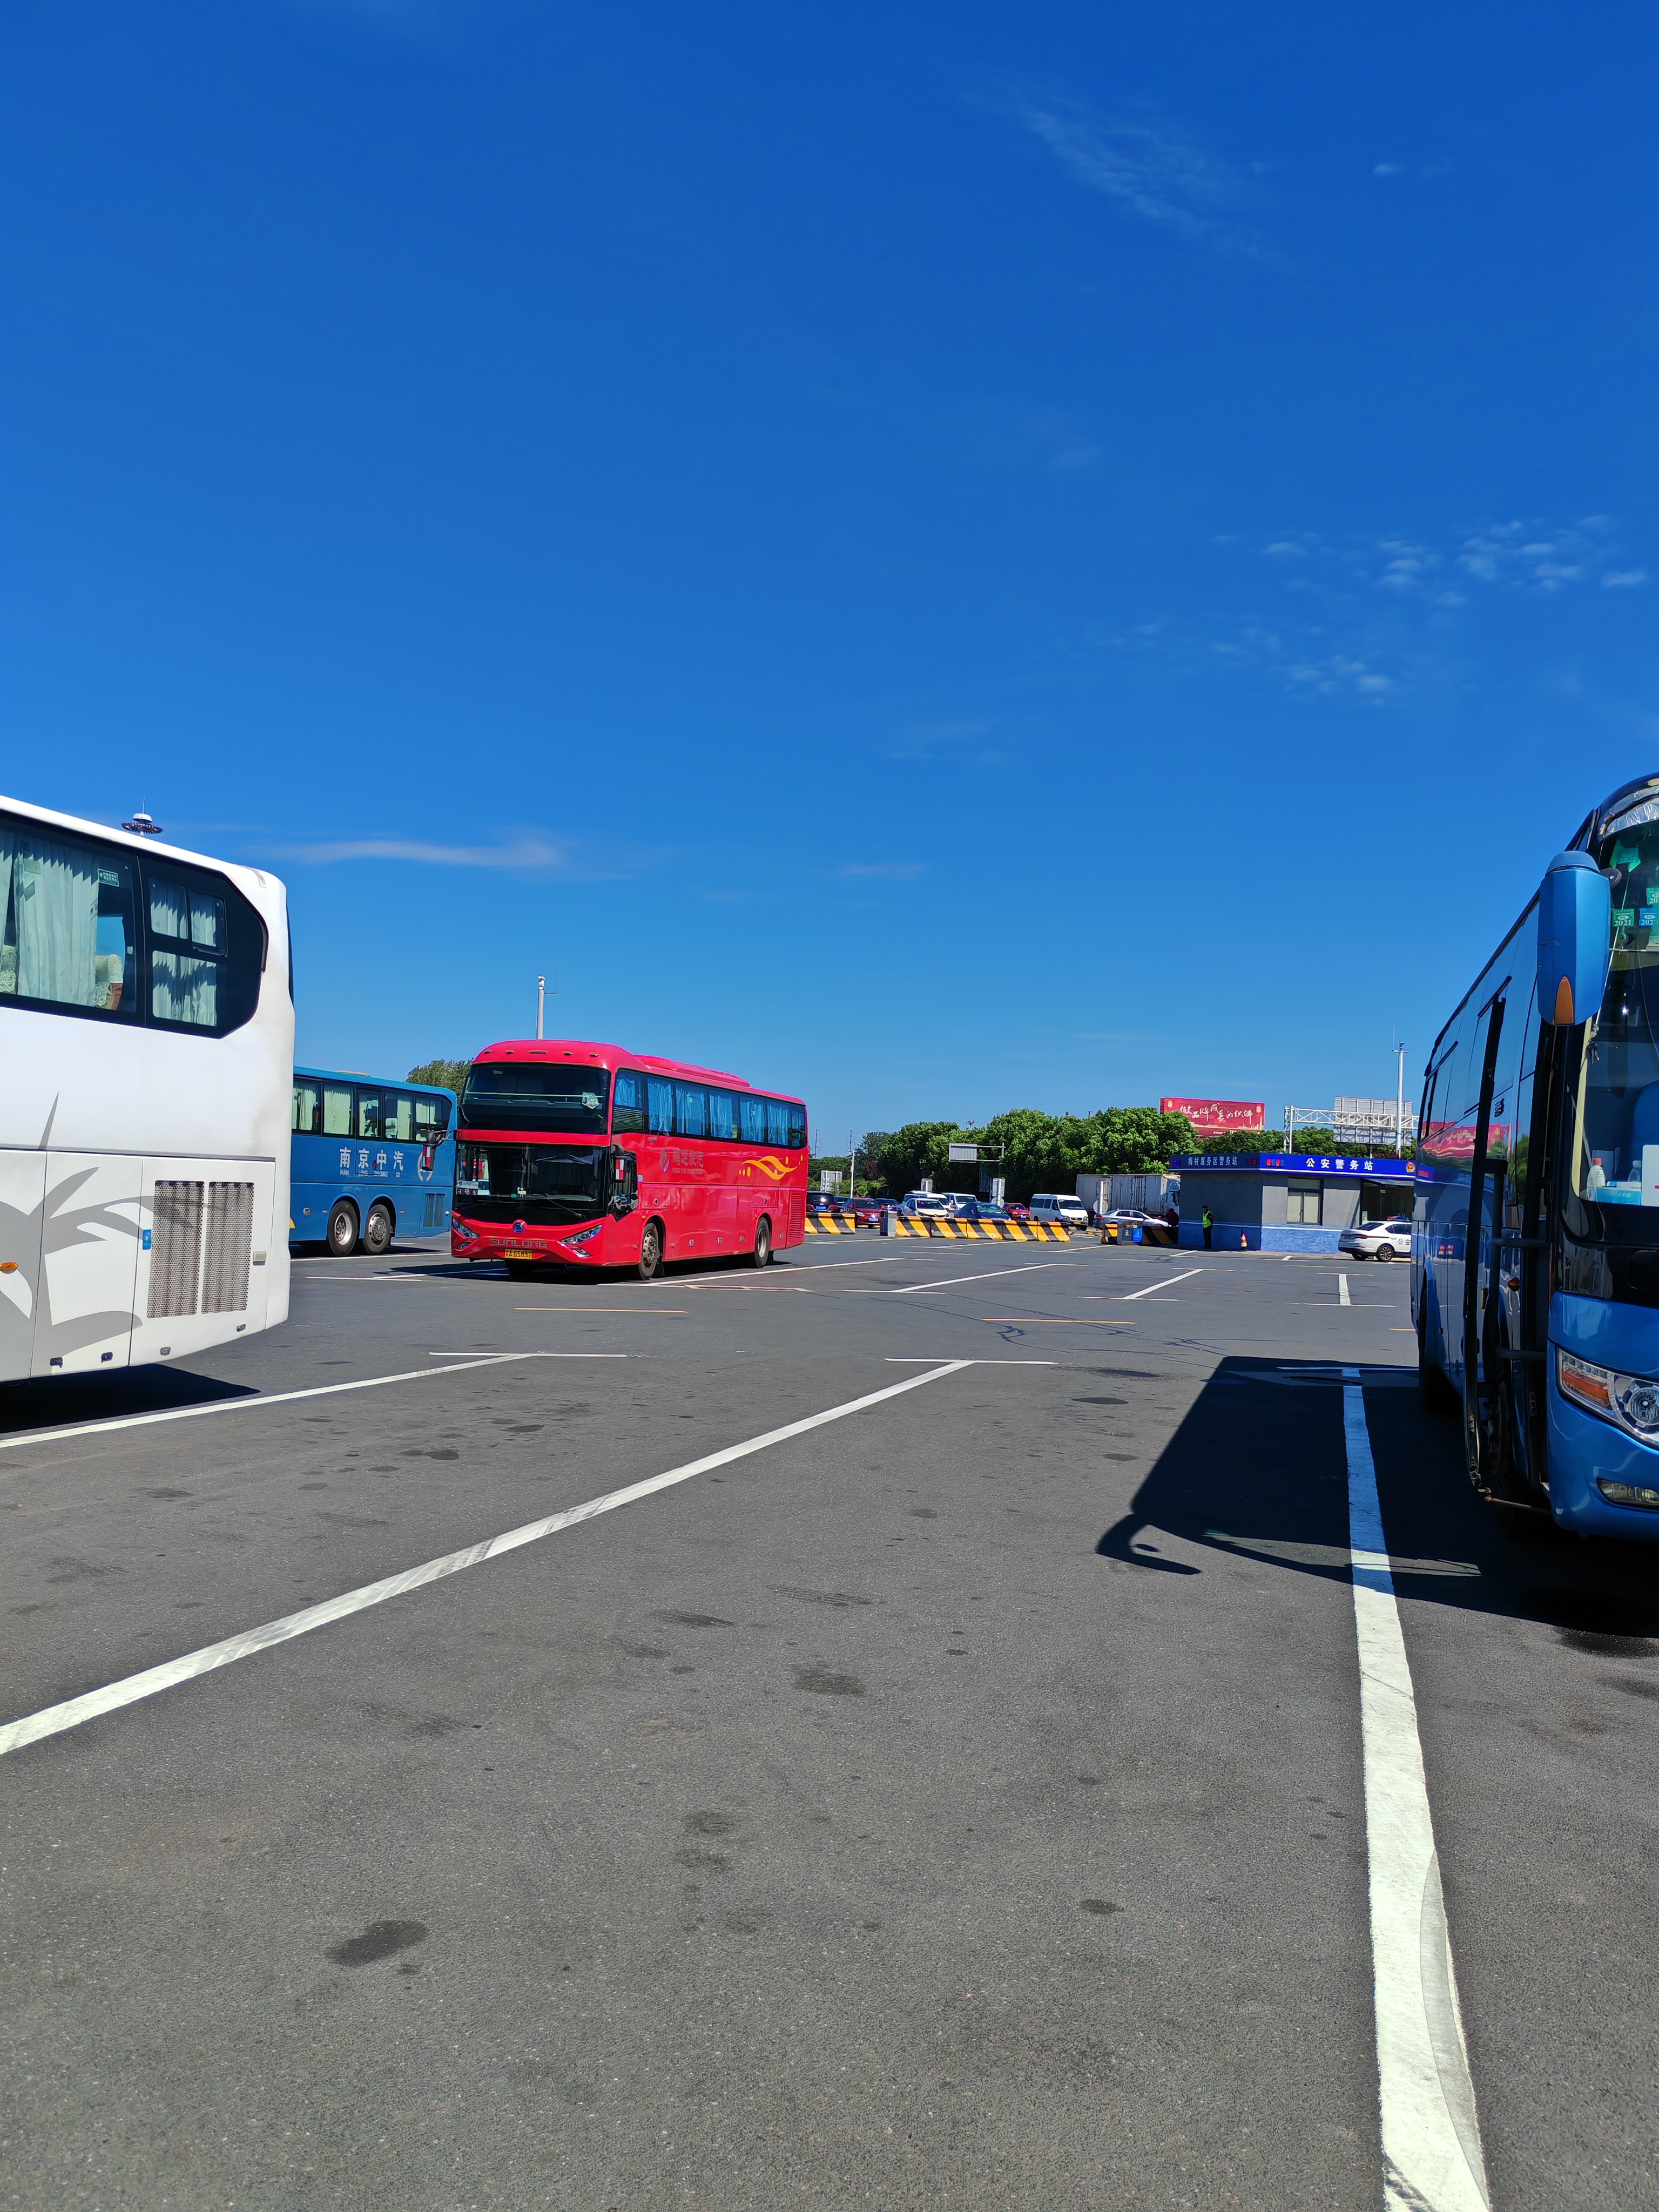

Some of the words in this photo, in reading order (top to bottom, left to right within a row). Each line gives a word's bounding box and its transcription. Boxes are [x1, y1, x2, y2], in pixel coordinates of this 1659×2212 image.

[340, 1147, 404, 1171] 南京中汽
[1188, 1156, 1238, 1166] 梅村服务区警务站
[1306, 1158, 1374, 1171] 公安警务站
[490, 1238, 548, 1248] SUNLONG
